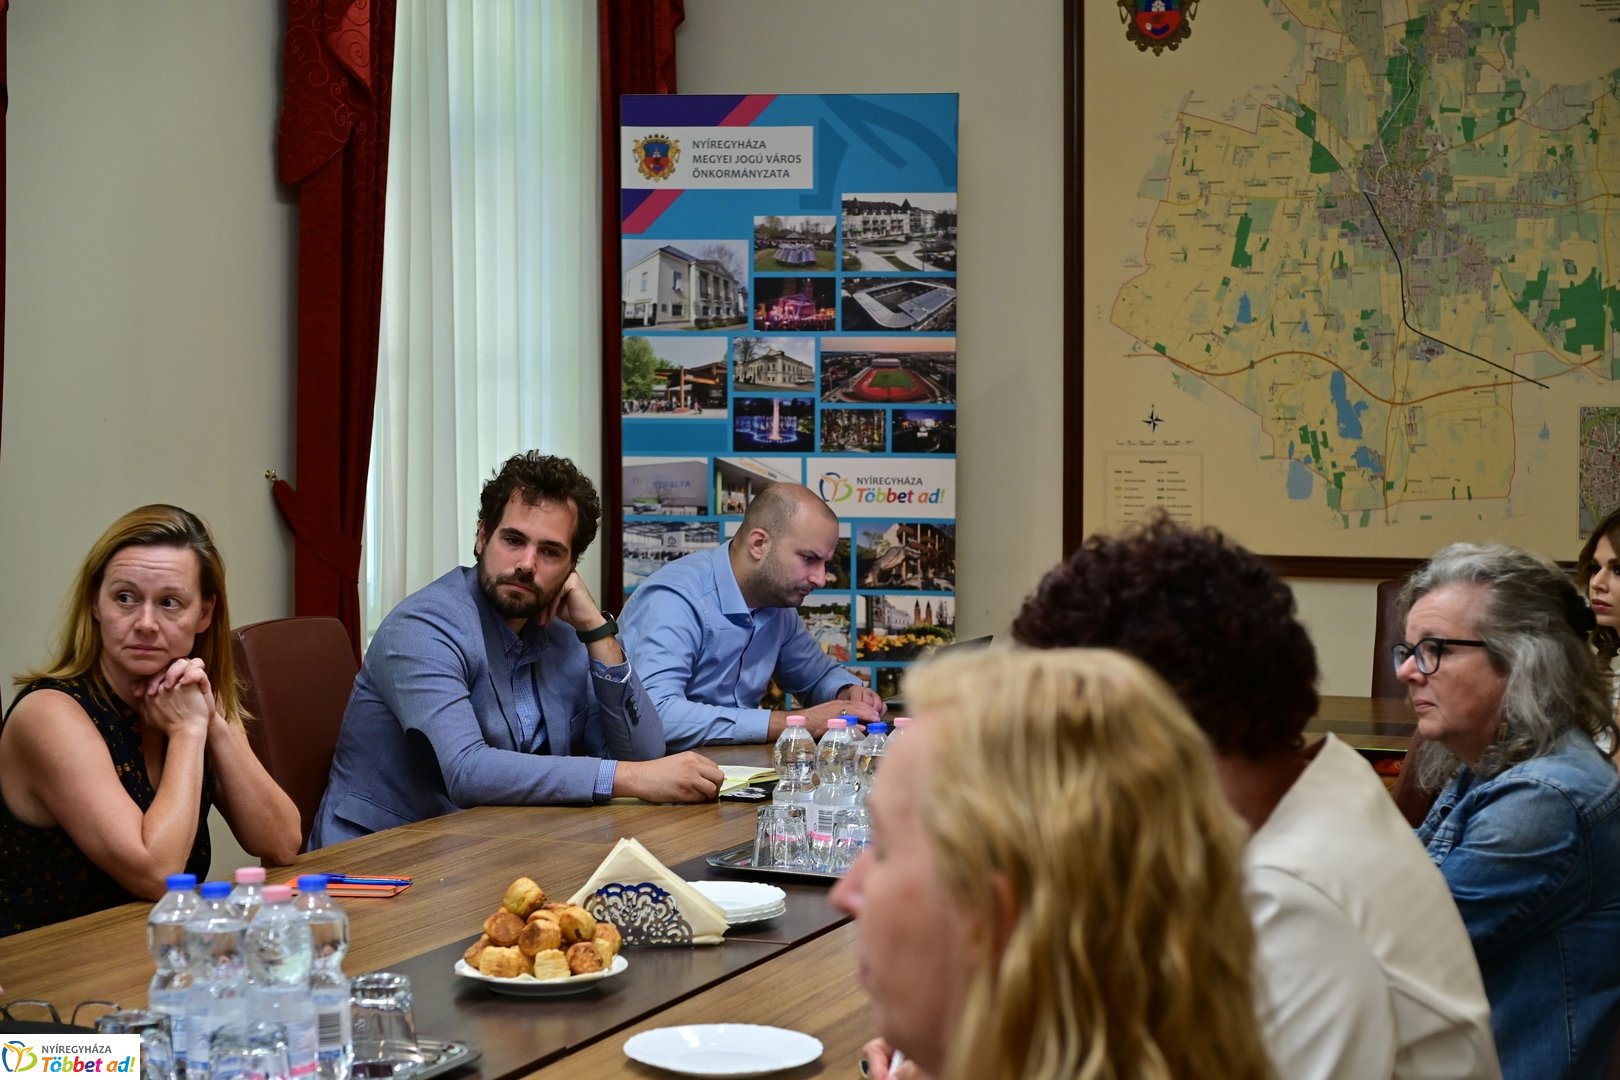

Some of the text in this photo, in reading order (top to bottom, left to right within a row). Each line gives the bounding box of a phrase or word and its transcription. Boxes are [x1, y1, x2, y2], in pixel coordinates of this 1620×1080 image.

[692, 139, 767, 149] NYÍREGYHÁZA
[692, 153, 802, 164] MEGYEI JOGÚ VÁROS
[692, 168, 790, 178] ÖNKORMÁNYZATA
[856, 476, 923, 486] NYÍREGYHÁZA
[856, 487, 946, 504] Többet ad!
